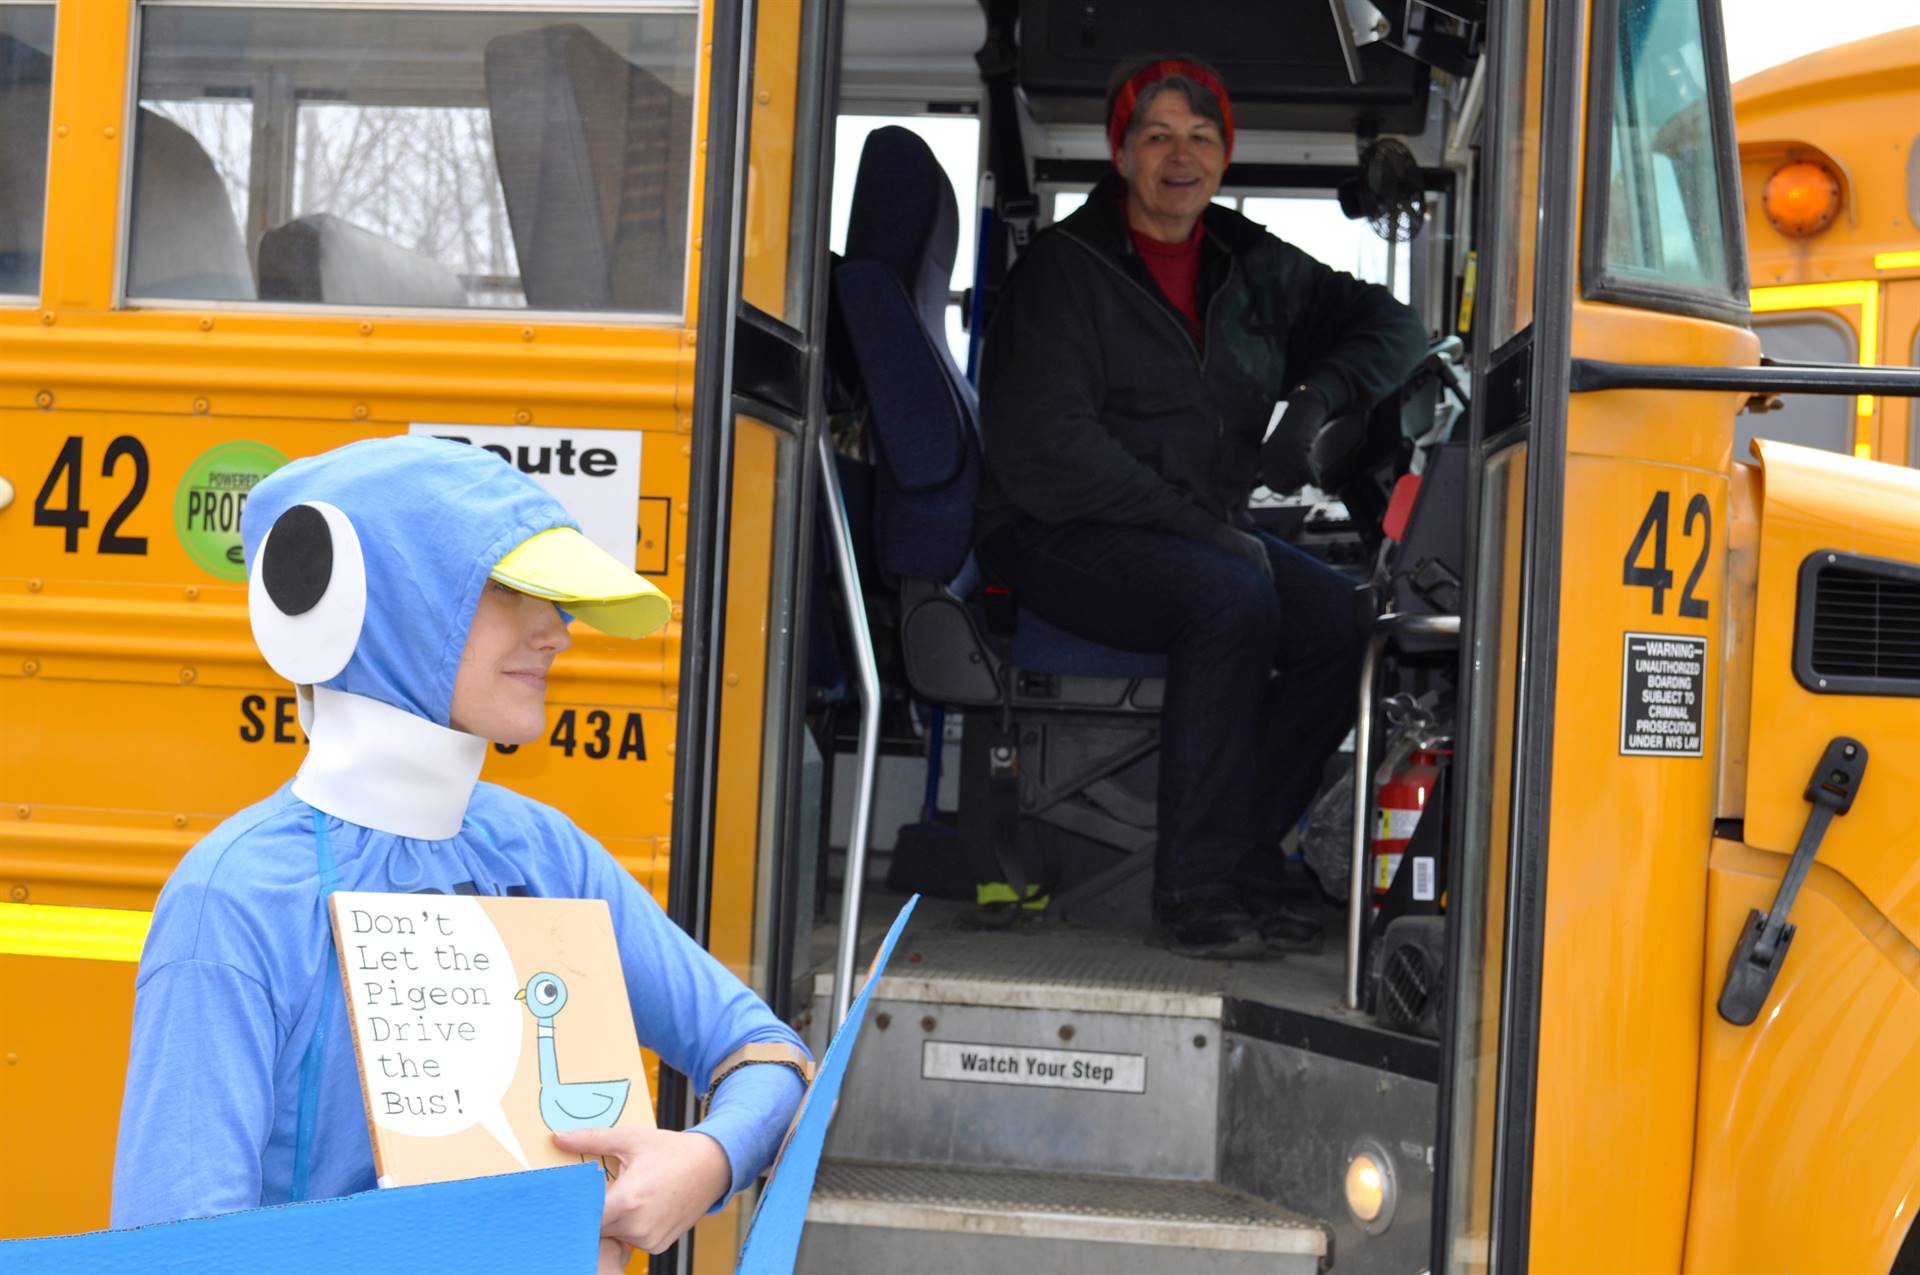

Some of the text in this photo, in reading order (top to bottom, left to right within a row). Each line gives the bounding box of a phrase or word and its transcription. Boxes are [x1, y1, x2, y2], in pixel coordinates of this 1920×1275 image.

[431, 435, 618, 477] ute
[34, 435, 150, 556] 42
[1623, 490, 1712, 619] 42
[1646, 641, 1695, 658] WARNING
[1635, 659, 1700, 675] UNAUTHORIZED
[1647, 675, 1692, 690] BOARDING
[1641, 689, 1695, 705] SUBJECT TO
[1648, 704, 1689, 720] CRIMINAL
[240, 694, 647, 761] SE 43A
[1636, 719, 1697, 735] PROSECUTION
[1628, 734, 1699, 750] UNDER NYS LAW
[350, 909, 453, 936] Don't
[356, 945, 491, 971] Let the
[363, 979, 491, 1011] Pigeon
[367, 1016, 476, 1042] Drive
[378, 1053, 441, 1078] the
[961, 1053, 1114, 1085] Watch Your Step
[381, 1089, 464, 1115] Bus!
